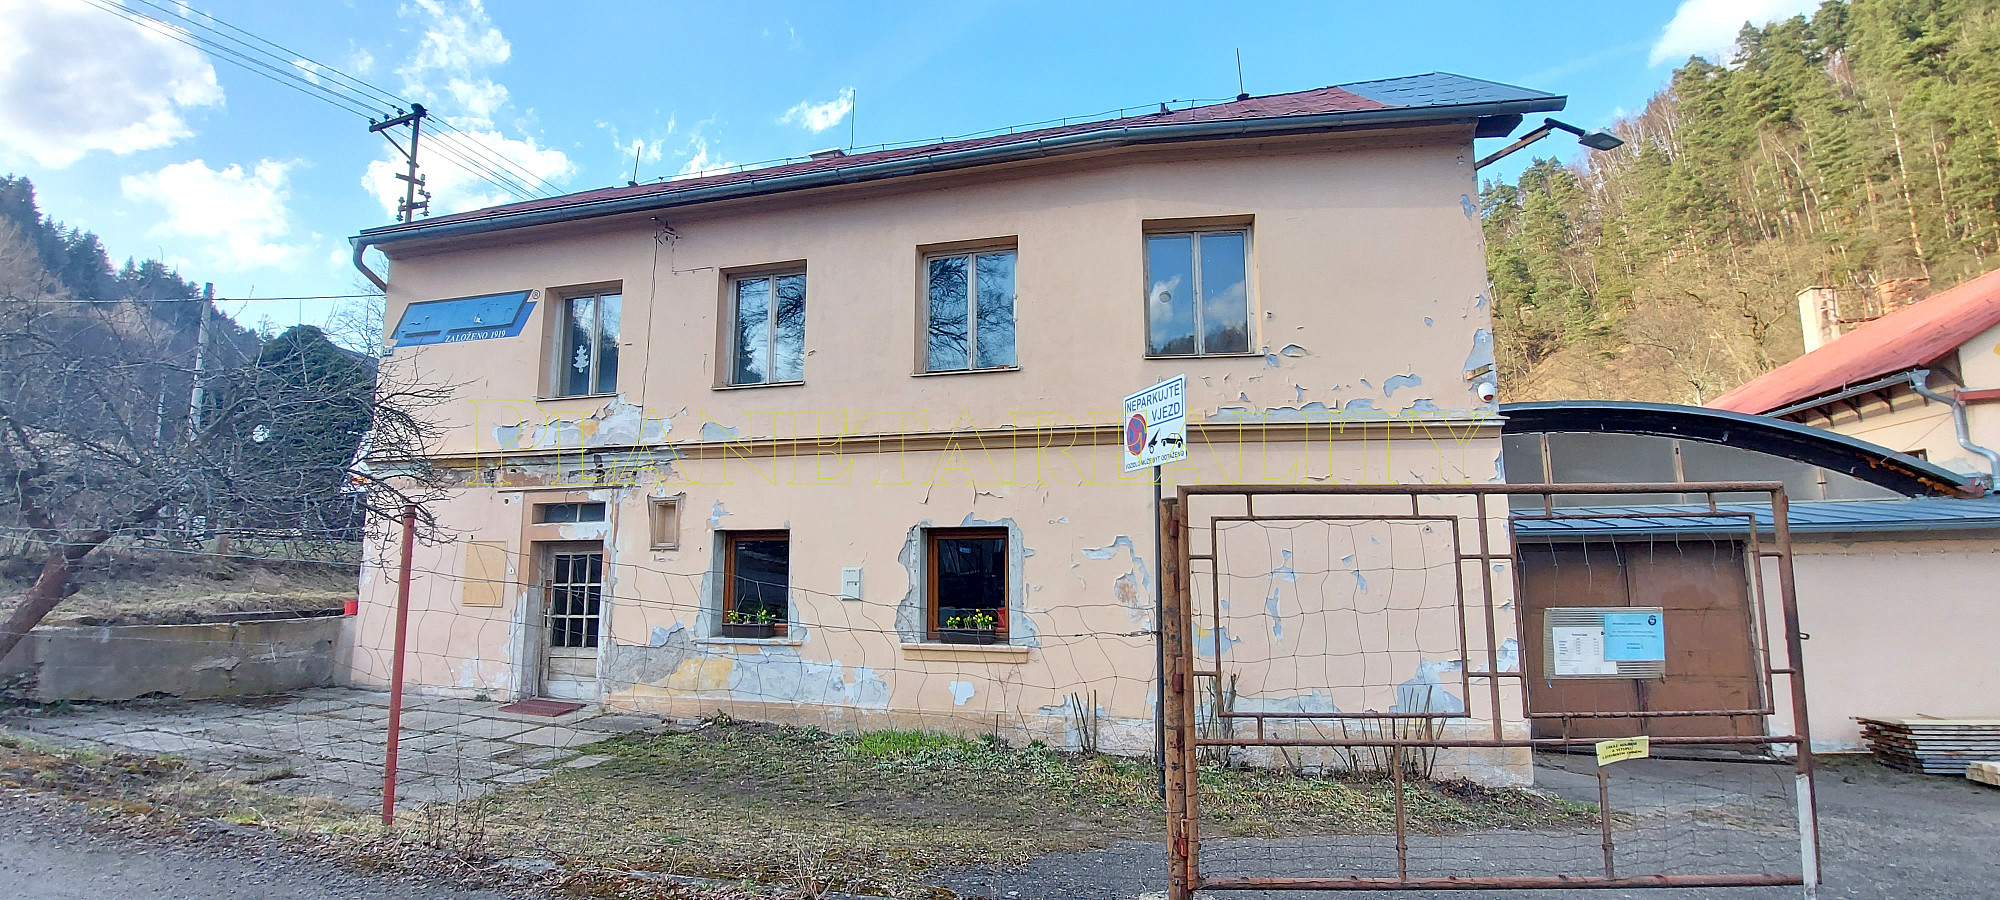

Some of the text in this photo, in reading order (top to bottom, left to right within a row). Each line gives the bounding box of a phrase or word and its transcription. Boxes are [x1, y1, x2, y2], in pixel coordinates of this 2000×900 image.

[445, 329, 506, 343] ZALOŽENO 1919
[1126, 383, 1180, 413] NEPARKUJTE
[1151, 401, 1181, 422] VJEZD
